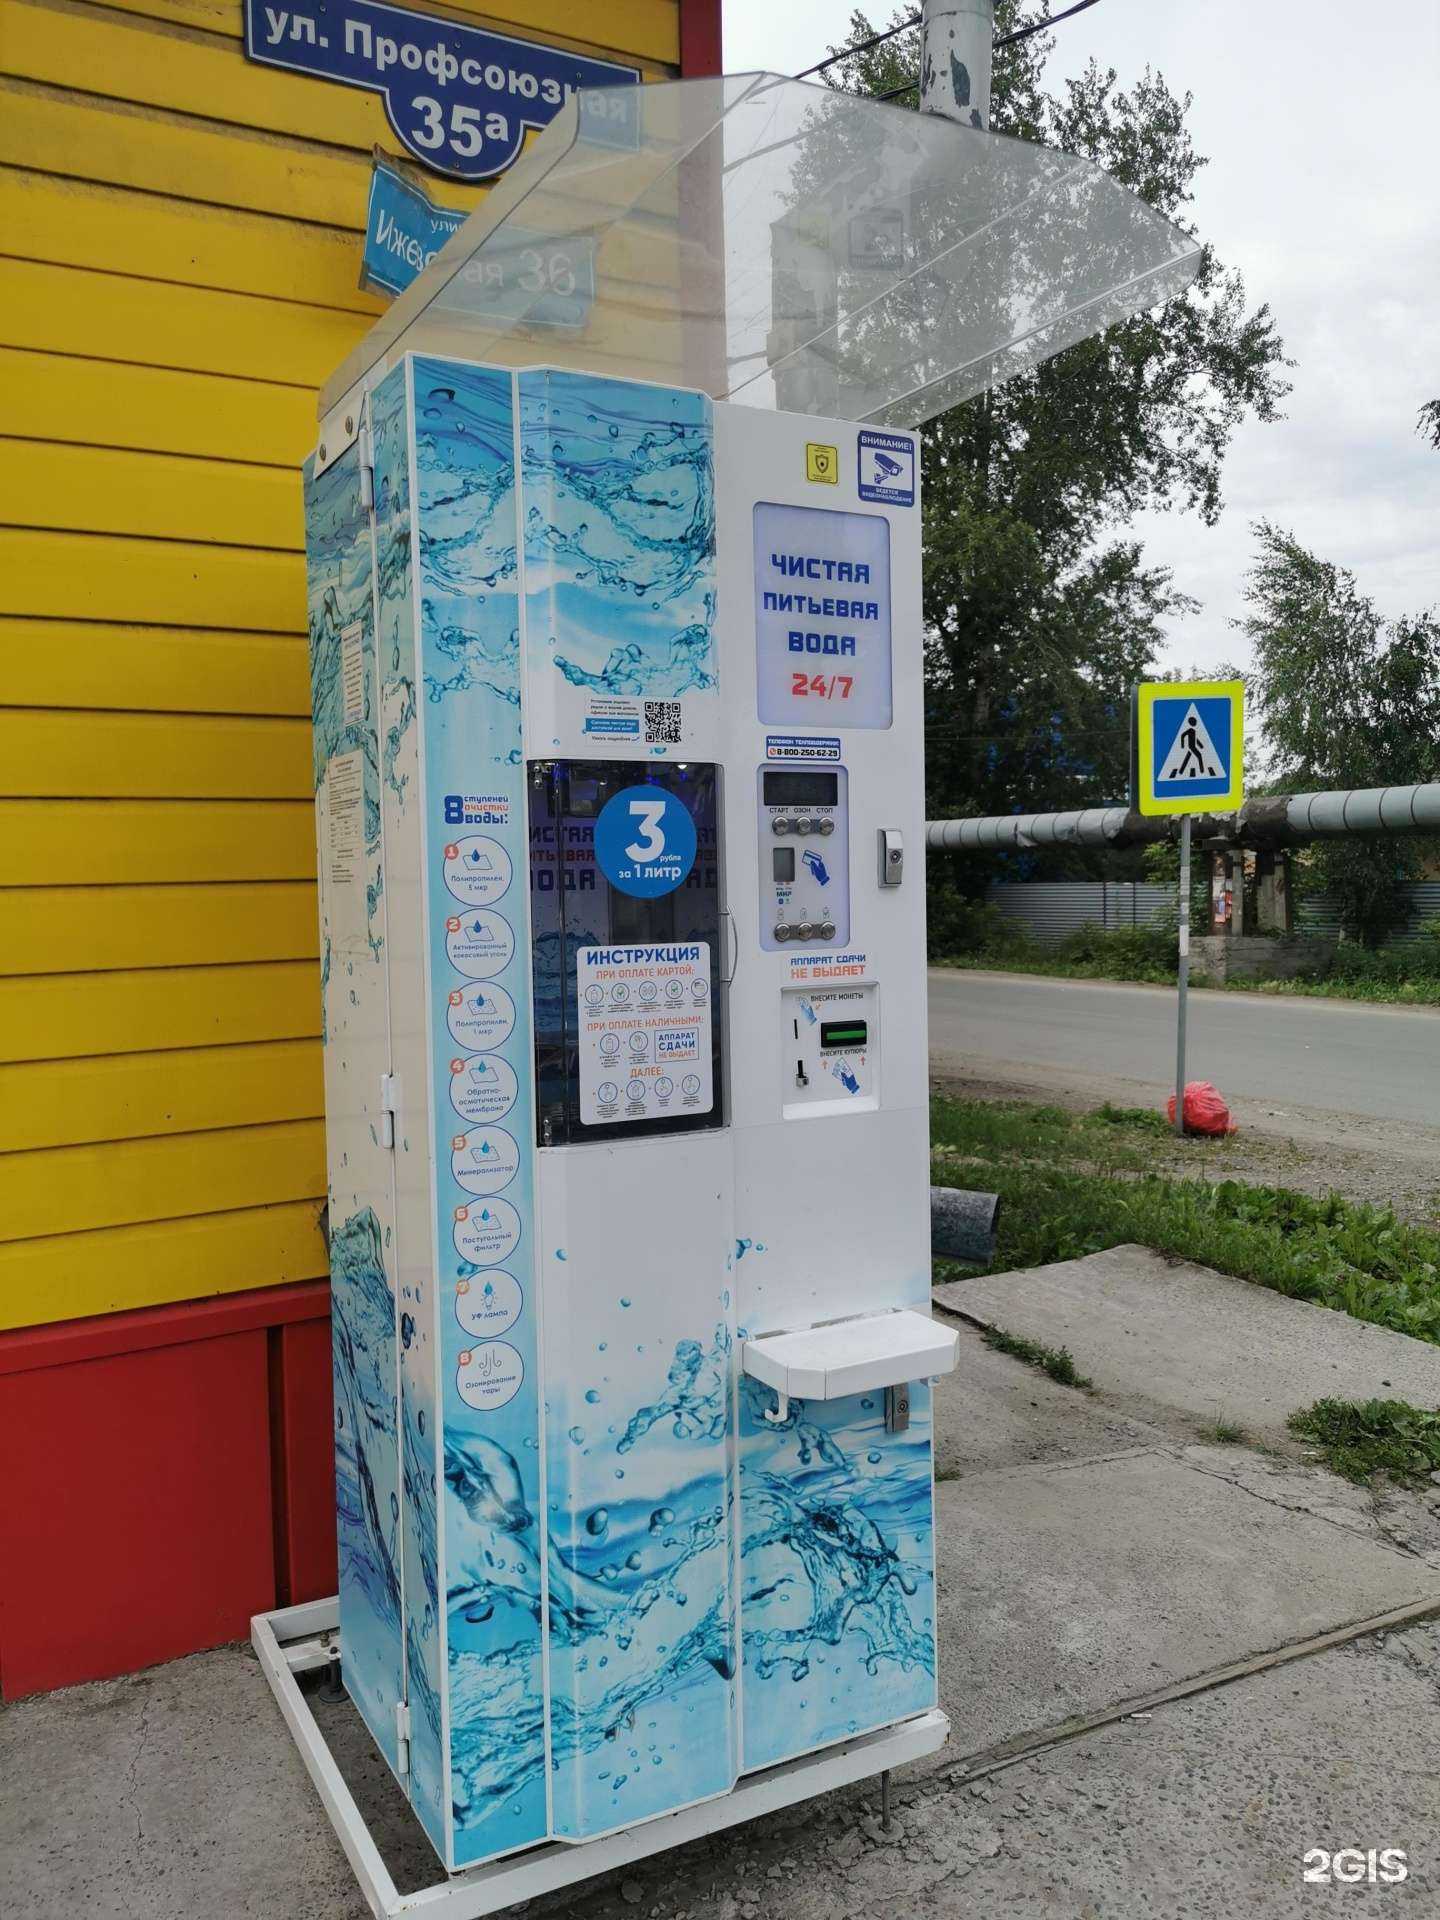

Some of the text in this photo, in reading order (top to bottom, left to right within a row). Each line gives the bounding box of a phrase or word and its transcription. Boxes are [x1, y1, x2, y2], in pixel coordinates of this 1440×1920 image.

[265, 7, 329, 48] ул.
[411, 95, 509, 158] 35а
[861, 435, 912, 451] ВНИМАНИЕ!
[771, 553, 870, 584] ЧИСТАЯ
[763, 592, 879, 620] ПИТЬЕВАЯ
[788, 631, 856, 656] ВОДА
[792, 673, 853, 700] 24/7
[445, 795, 464, 824] 8
[464, 804, 509, 812] очистки
[465, 811, 508, 824] воды:
[625, 800, 666, 863] 3
[618, 864, 682, 881] за 1 литр
[587, 946, 700, 965] ИНСТРУКЦИЯ
[790, 954, 866, 965] АППАРАТ СДАЧИ
[596, 970, 616, 980] ПРИ
[619, 967, 654, 978] ОПЛАТЕ
[791, 965, 866, 979] НЕ ВЫДАЕТ
[810, 993, 838, 1002] ВНЕСИТЕ
[587, 1023, 605, 1032] ПРИ
[608, 1020, 641, 1030] ОПЛАТЕ
[659, 1032, 695, 1041] АППАРАТ
[659, 1041, 695, 1051] СДАЧИ
[630, 1066, 664, 1078] ДАЛЕЕ:
